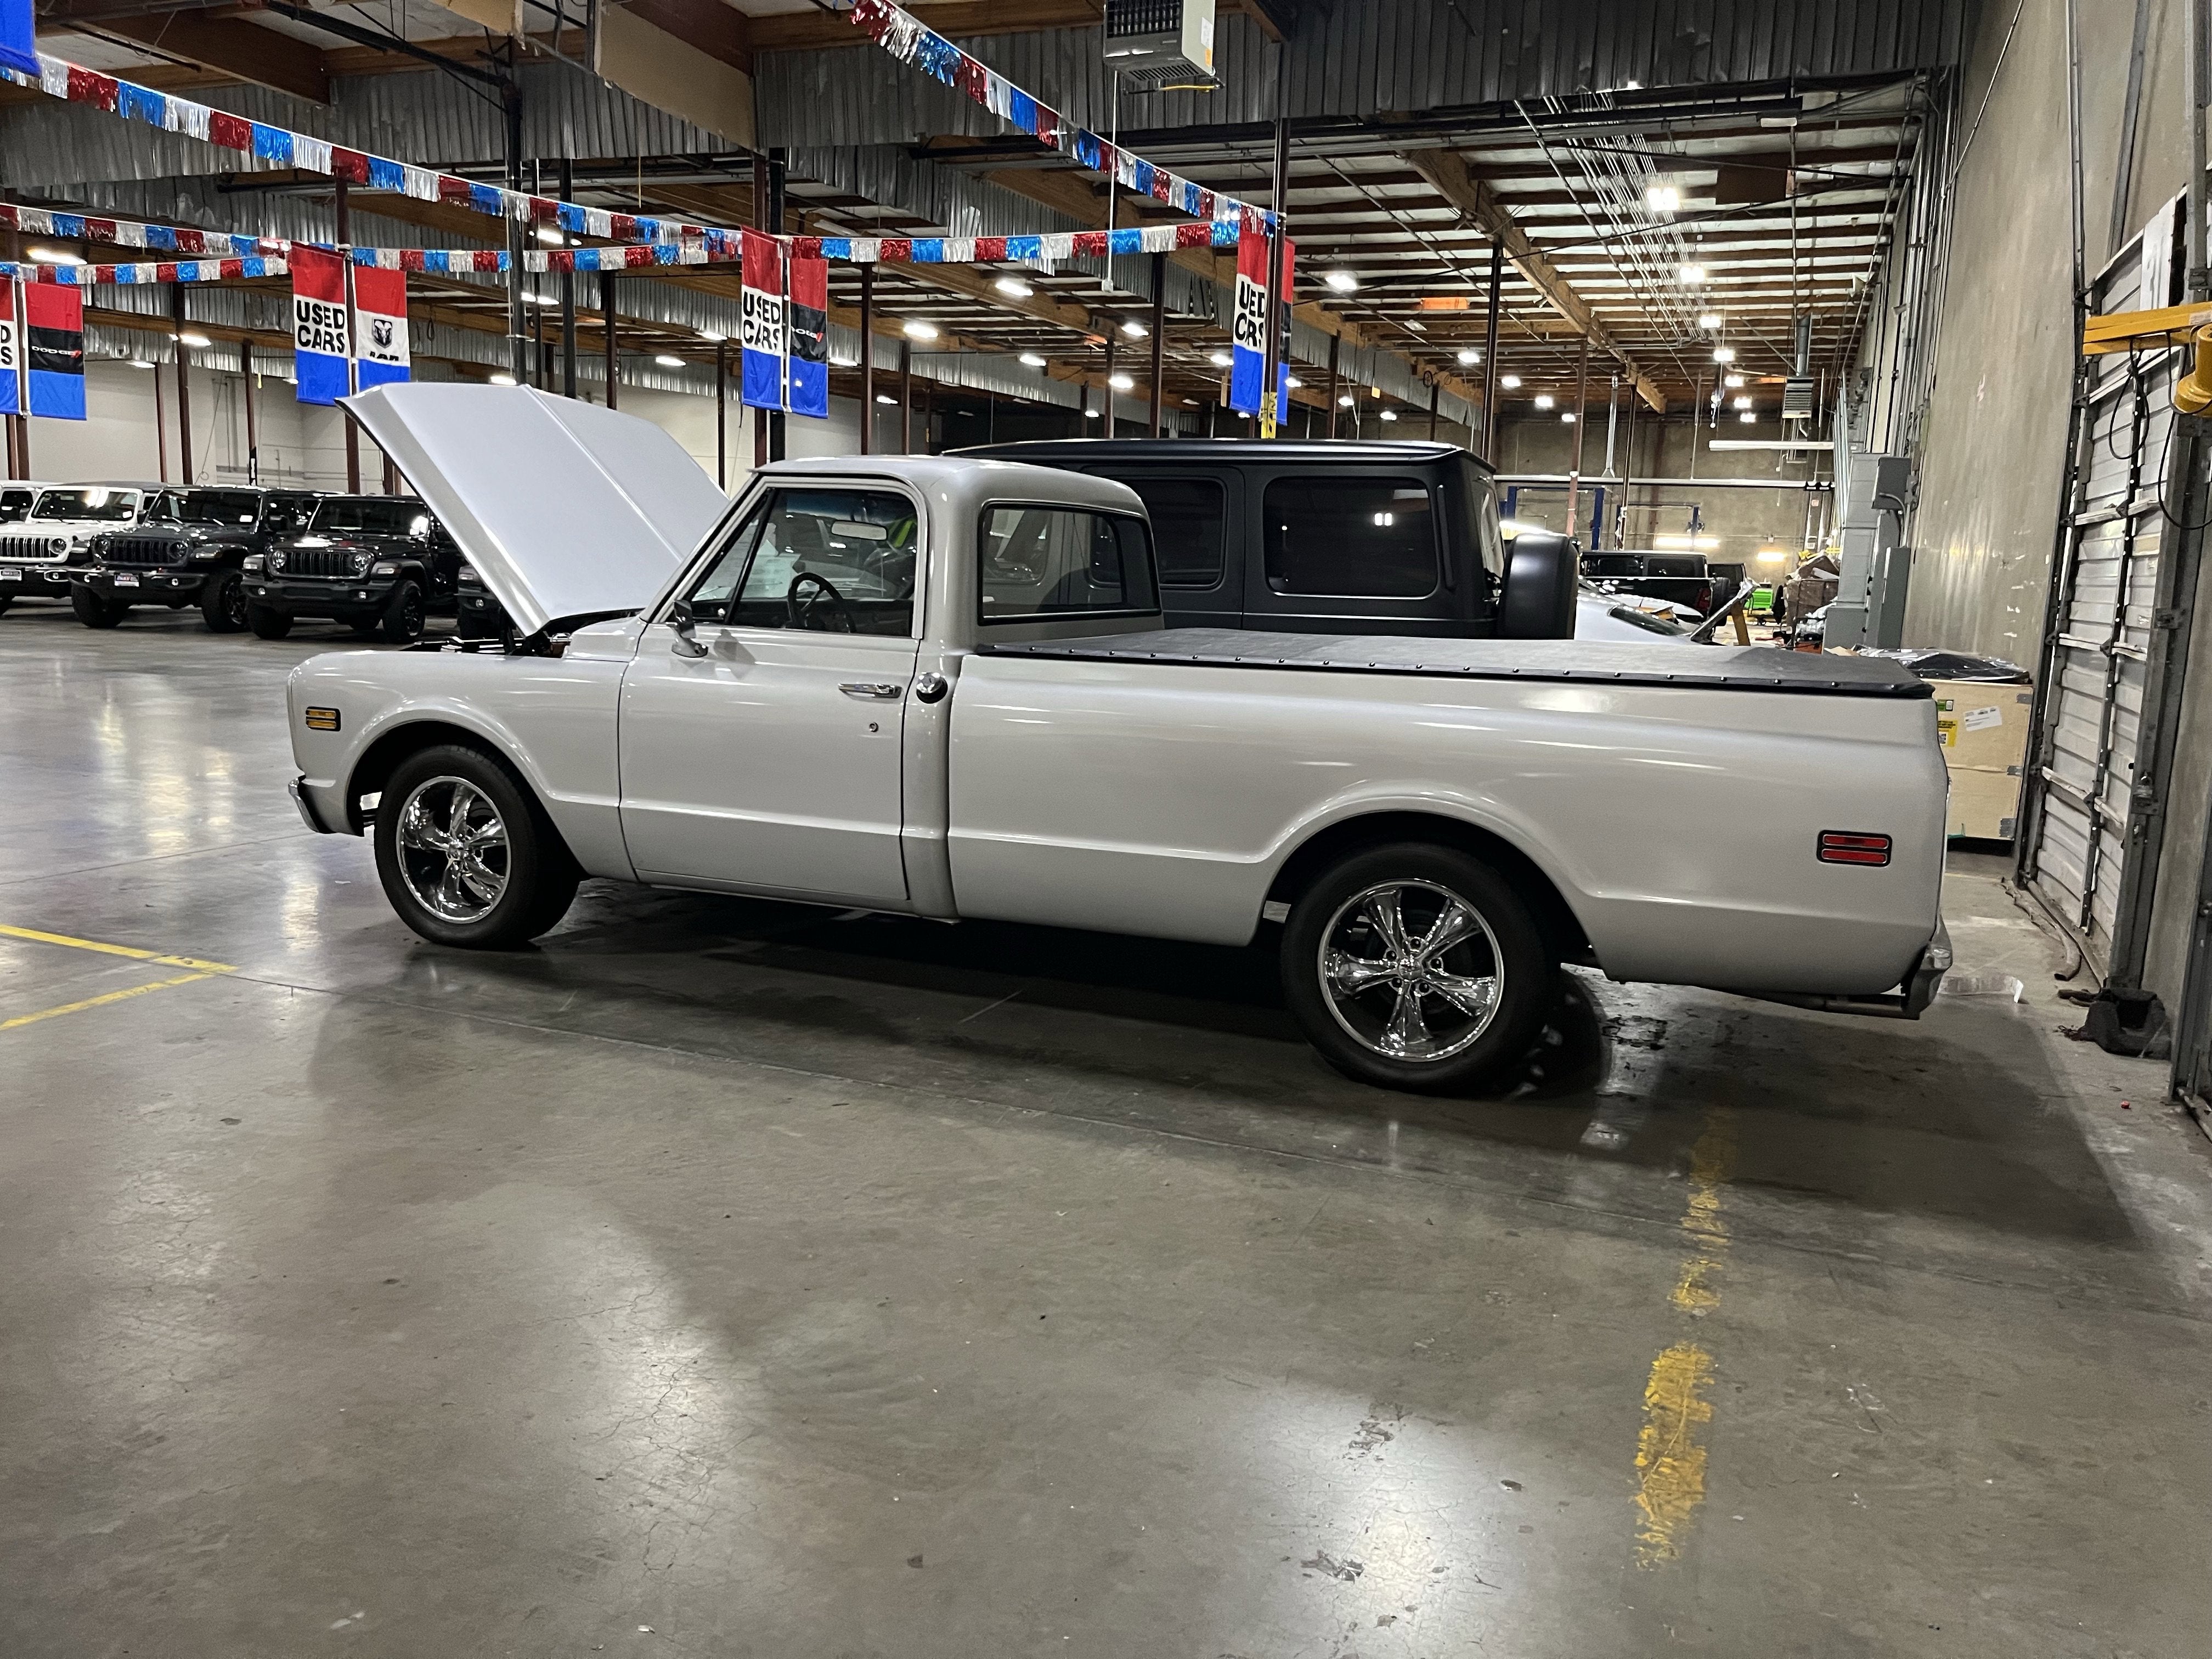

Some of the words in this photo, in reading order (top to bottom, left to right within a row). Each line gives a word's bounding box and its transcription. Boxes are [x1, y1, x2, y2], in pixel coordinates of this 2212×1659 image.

[1239, 281, 1265, 318] UED
[297, 300, 345, 329] USED
[298, 325, 345, 353] CARS
